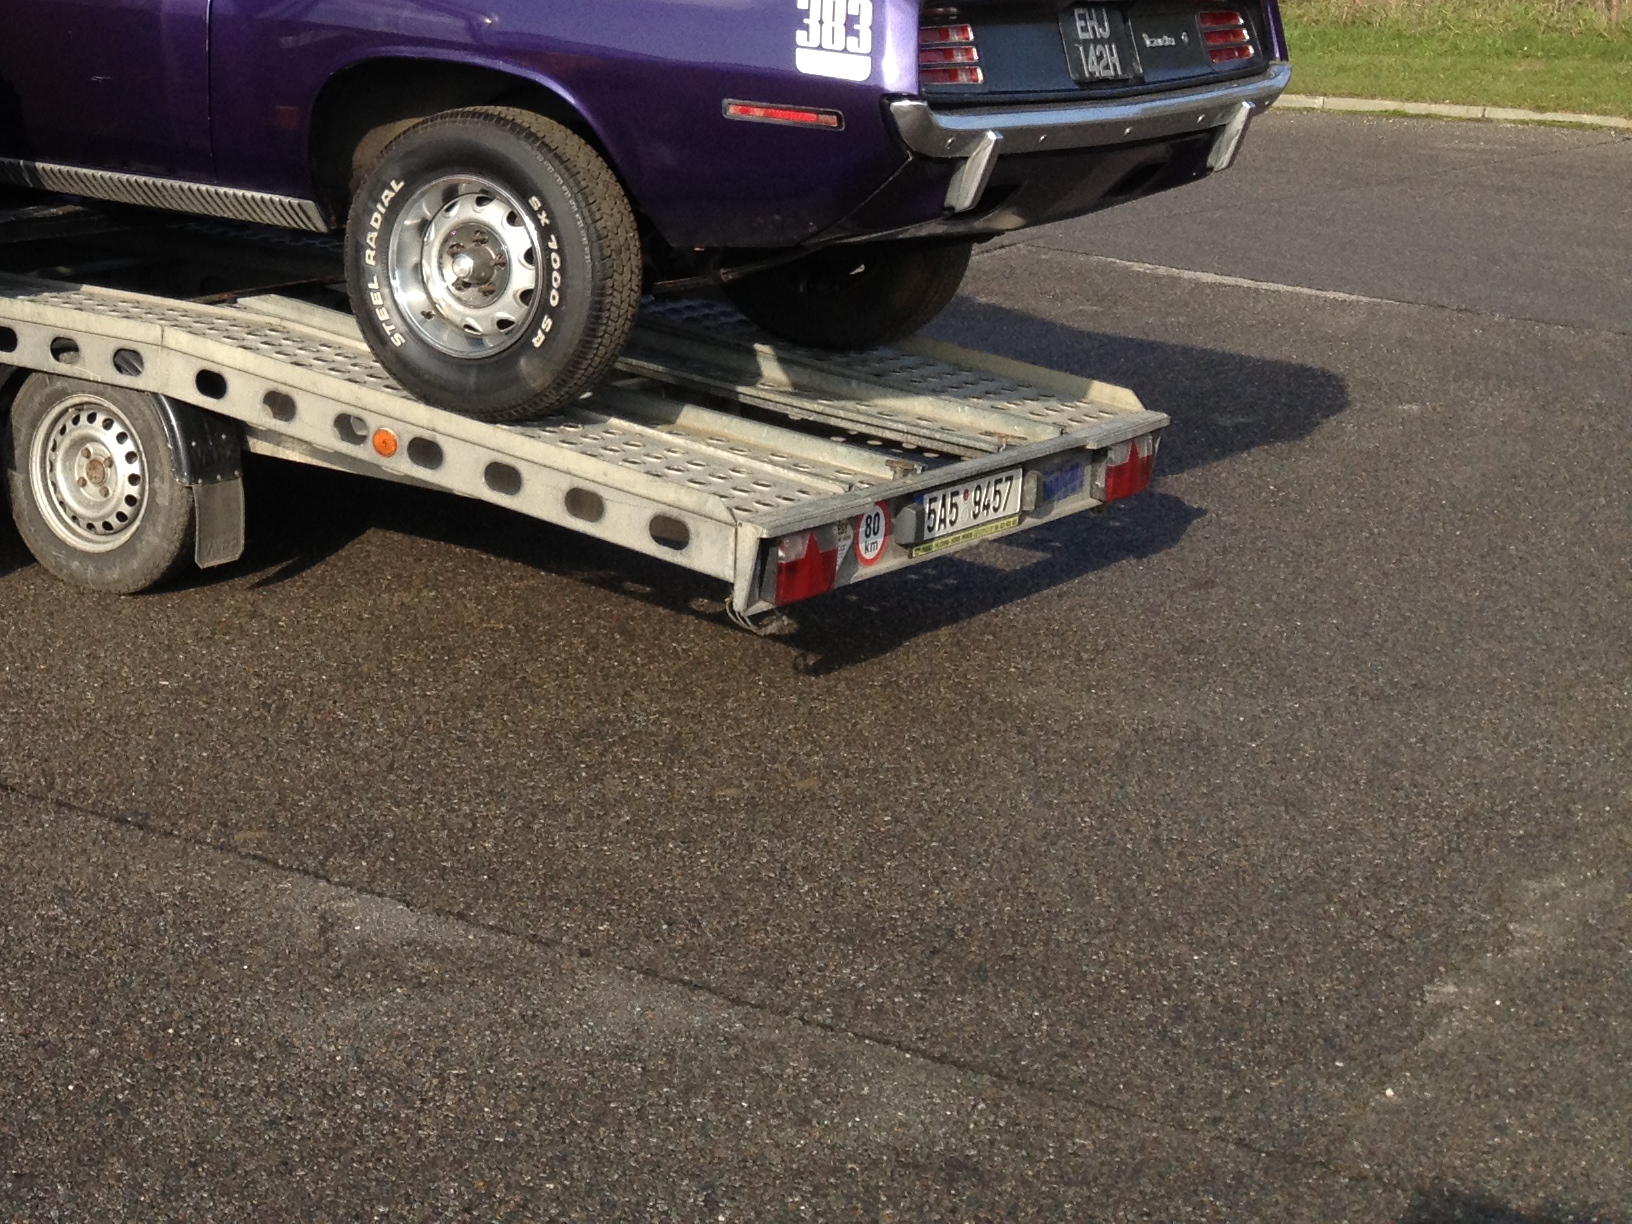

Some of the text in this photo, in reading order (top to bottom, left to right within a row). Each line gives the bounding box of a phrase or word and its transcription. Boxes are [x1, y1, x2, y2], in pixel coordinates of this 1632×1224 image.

[1074, 7, 1111, 40] EHJ
[1075, 42, 1123, 78] 142H
[364, 178, 406, 348] STEEL RADIAL
[528, 195, 562, 348] SX 7000 SR
[926, 475, 1014, 534] 5A5 9457
[864, 511, 881, 539] 80
[864, 539, 879, 553] km
